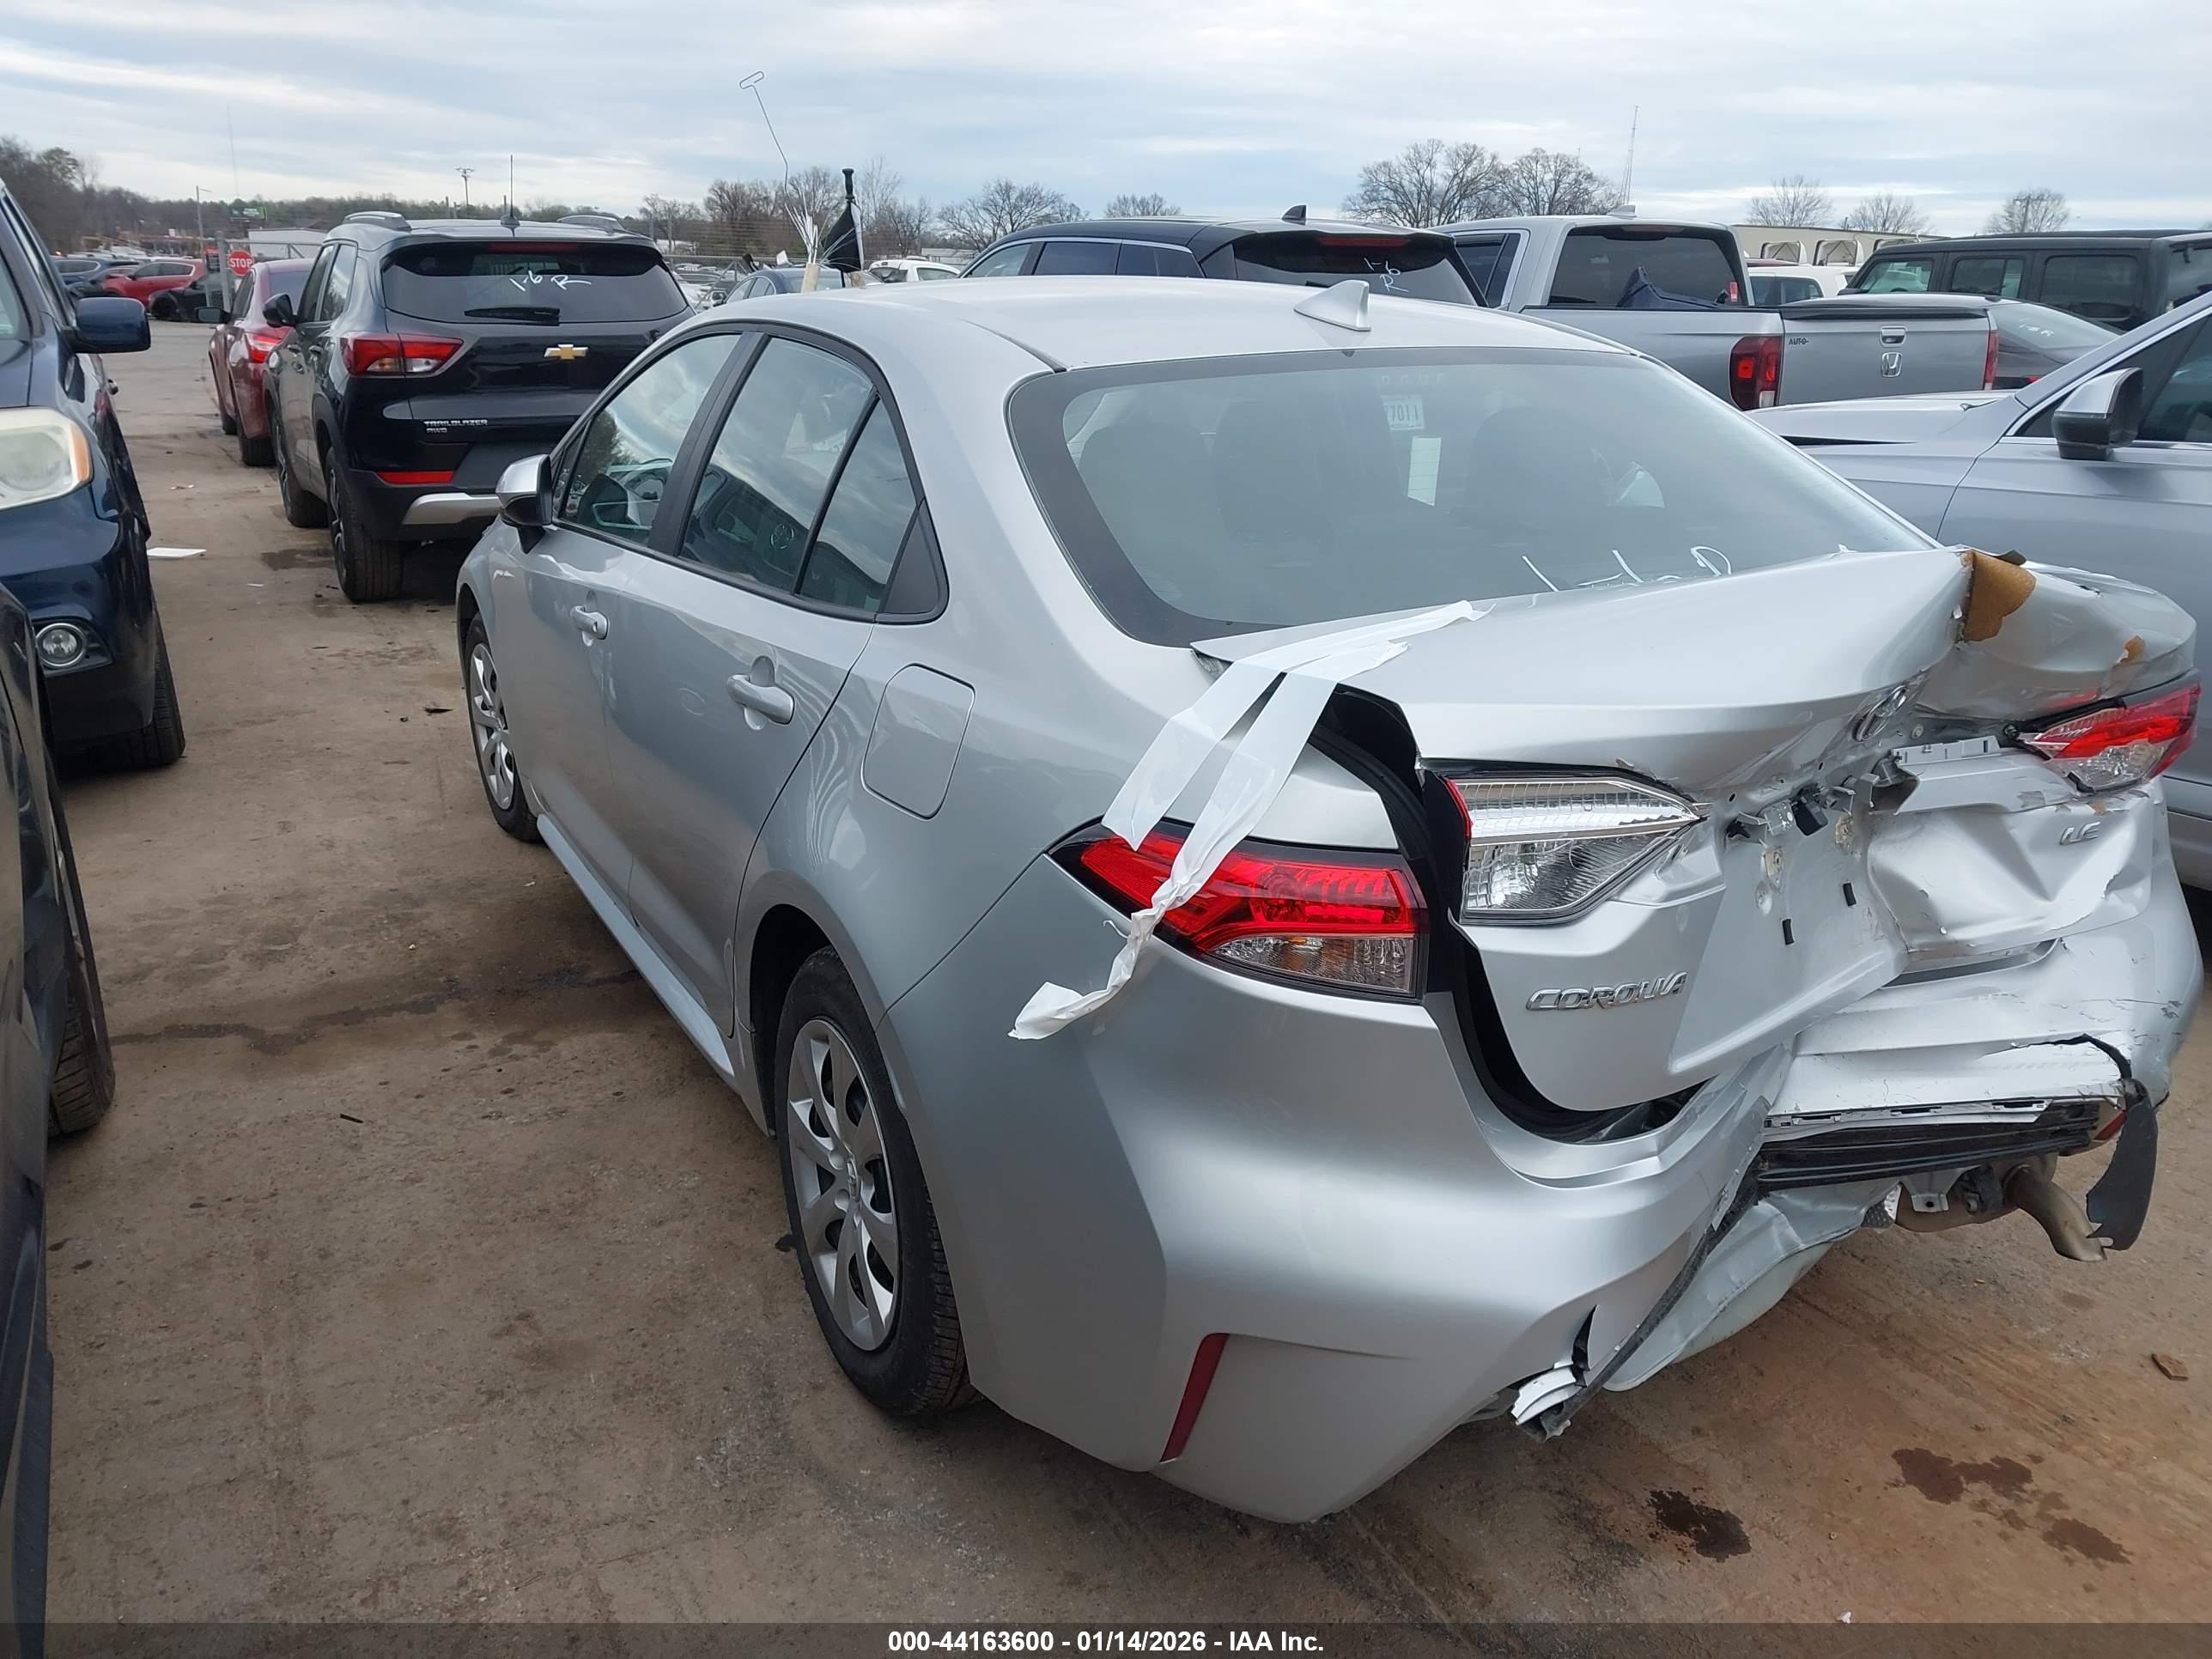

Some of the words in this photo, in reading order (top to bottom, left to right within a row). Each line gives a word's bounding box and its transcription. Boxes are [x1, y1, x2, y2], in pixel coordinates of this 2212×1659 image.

[229, 258, 252, 269] STOP
[1379, 274, 1409, 293] R
[2059, 821, 2101, 845] LE
[1526, 971, 1689, 1011] COROLLA
